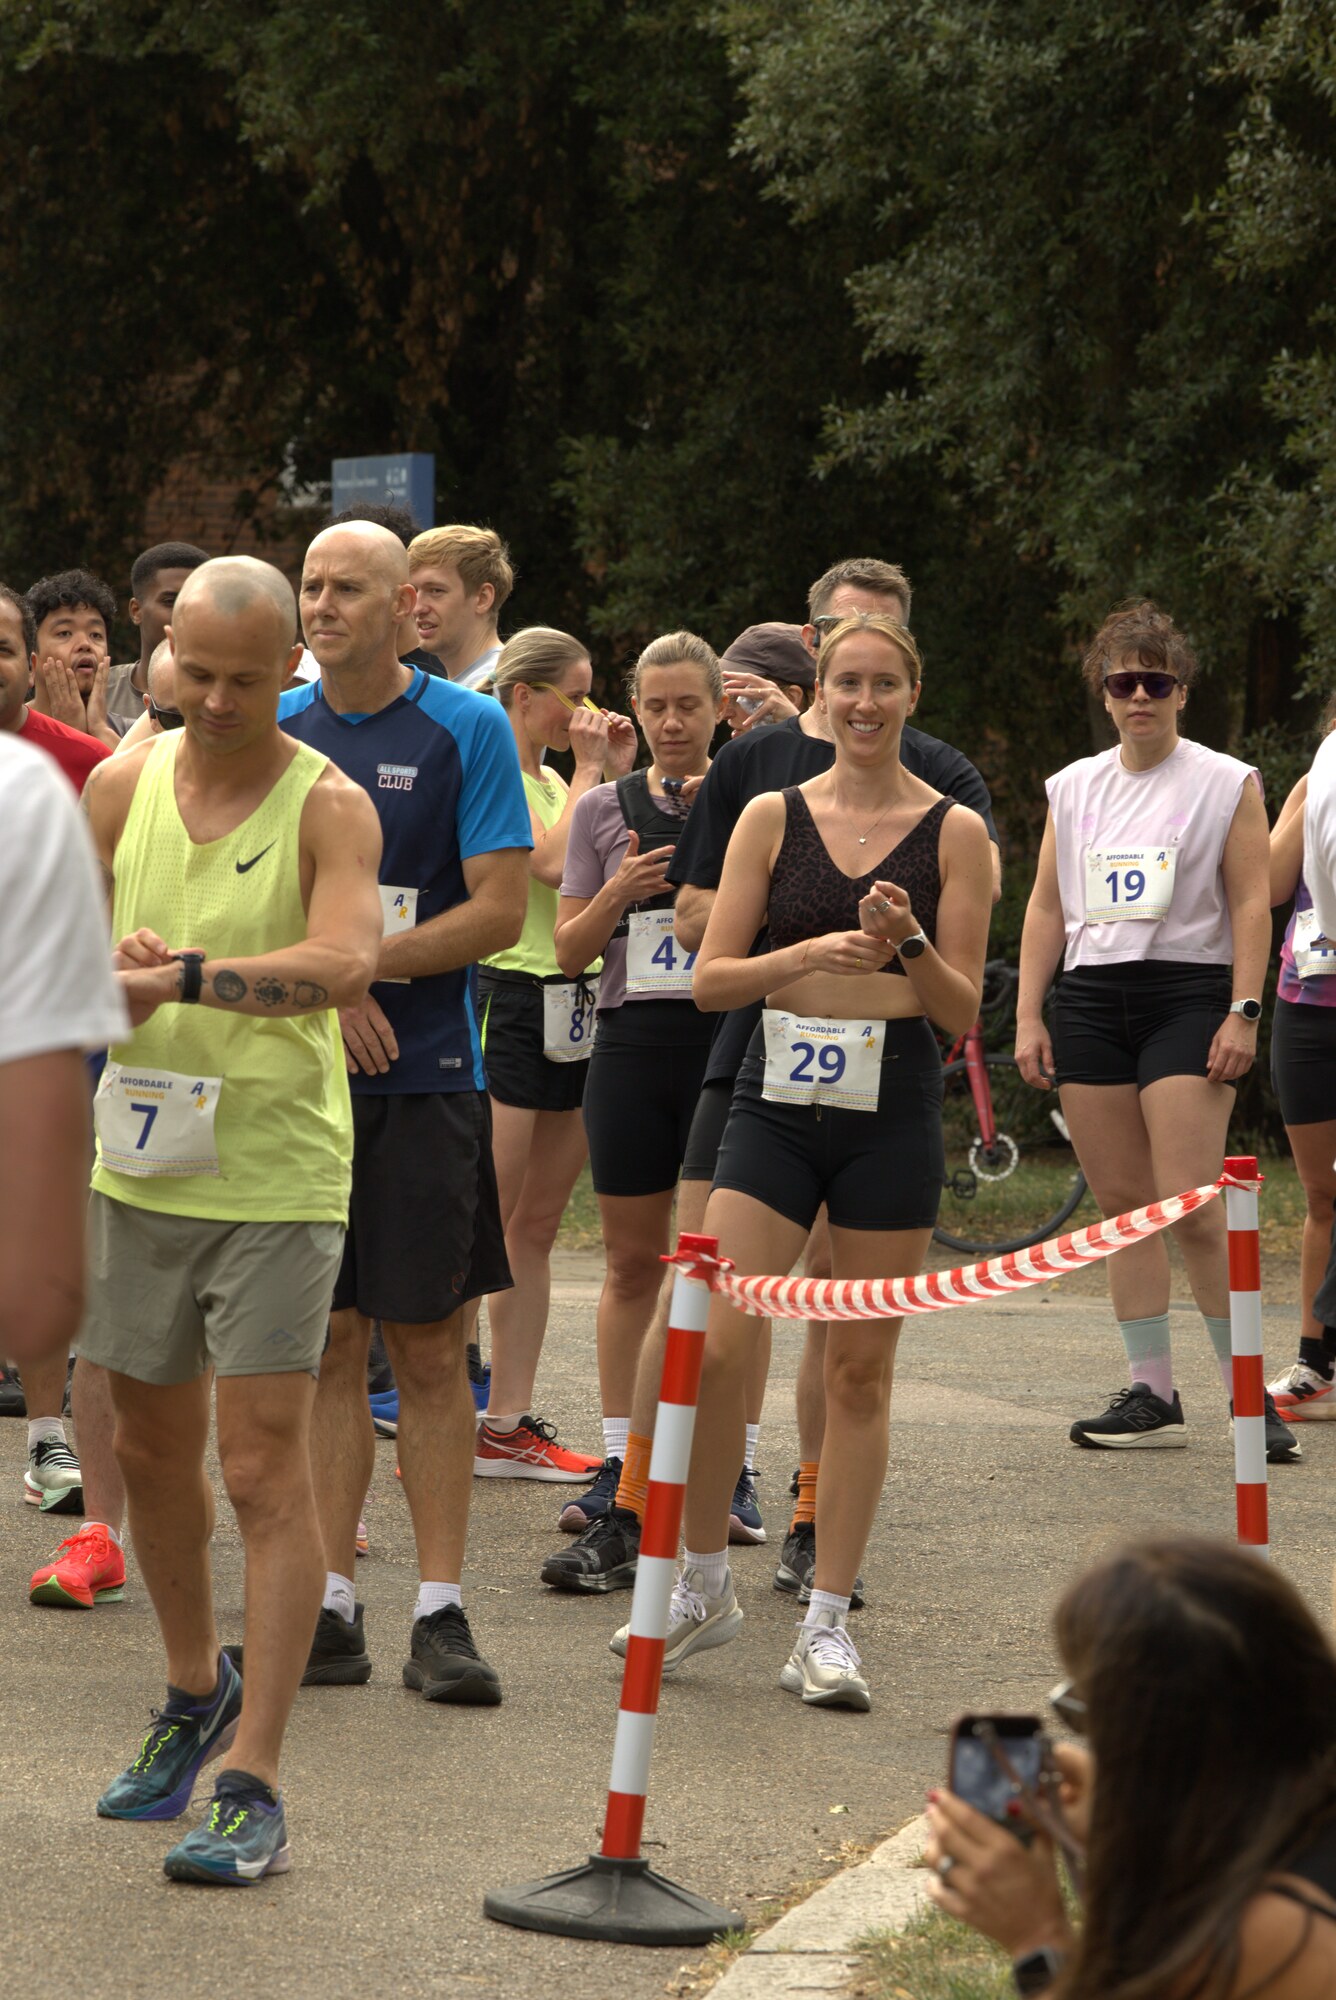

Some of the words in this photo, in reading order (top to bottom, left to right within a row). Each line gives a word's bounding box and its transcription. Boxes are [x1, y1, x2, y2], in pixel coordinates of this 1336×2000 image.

[391, 768, 415, 776] SPORTS
[378, 775, 413, 790] CLUB
[1157, 852, 1165, 861] A
[1161, 861, 1168, 870] R
[1105, 870, 1145, 903] 19
[394, 894, 404, 907] A
[399, 906, 408, 918] R
[796, 1024, 846, 1034] AFFORDABLE
[861, 1026, 872, 1037] A
[800, 1031, 839, 1041] RUNNING
[865, 1037, 876, 1048] R
[789, 1042, 846, 1084] 29
[120, 1077, 173, 1090] AFFORDABLE
[190, 1082, 204, 1095] A
[125, 1088, 165, 1100] RUNNING
[195, 1095, 207, 1110] R
[130, 1103, 158, 1150] 7
